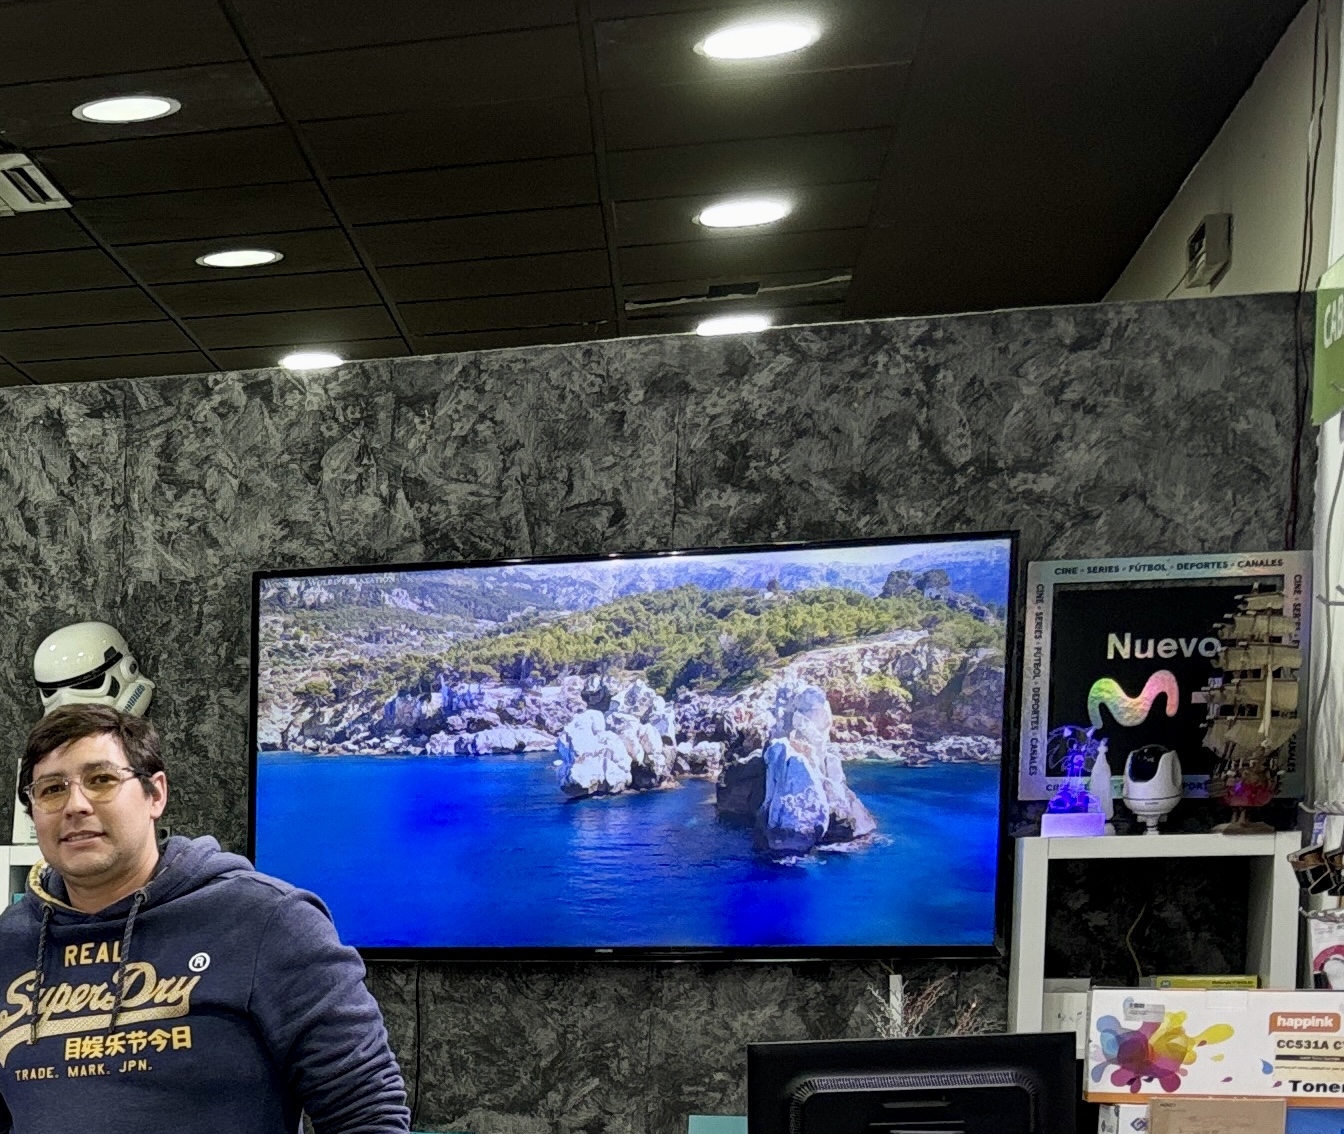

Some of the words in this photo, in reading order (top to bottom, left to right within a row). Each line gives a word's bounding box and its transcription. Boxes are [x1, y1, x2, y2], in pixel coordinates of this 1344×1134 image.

[1054, 566, 1078, 576] CINE
[1086, 564, 1120, 574] SERIES
[1128, 561, 1168, 573] FÚTBOL
[1176, 560, 1228, 571] DEPORTES
[1237, 557, 1284, 568] CANALES
[1106, 632, 1222, 661] Nuevo
[1028, 734, 1039, 776] CANALES
[64, 941, 126, 968] REAL
[1276, 1015, 1334, 1030] happink
[1276, 1039, 1328, 1050] CC531A
[15, 1066, 60, 1082] TRADE.
[67, 1062, 111, 1079] MARK.
[119, 1057, 153, 1074] JPN.
